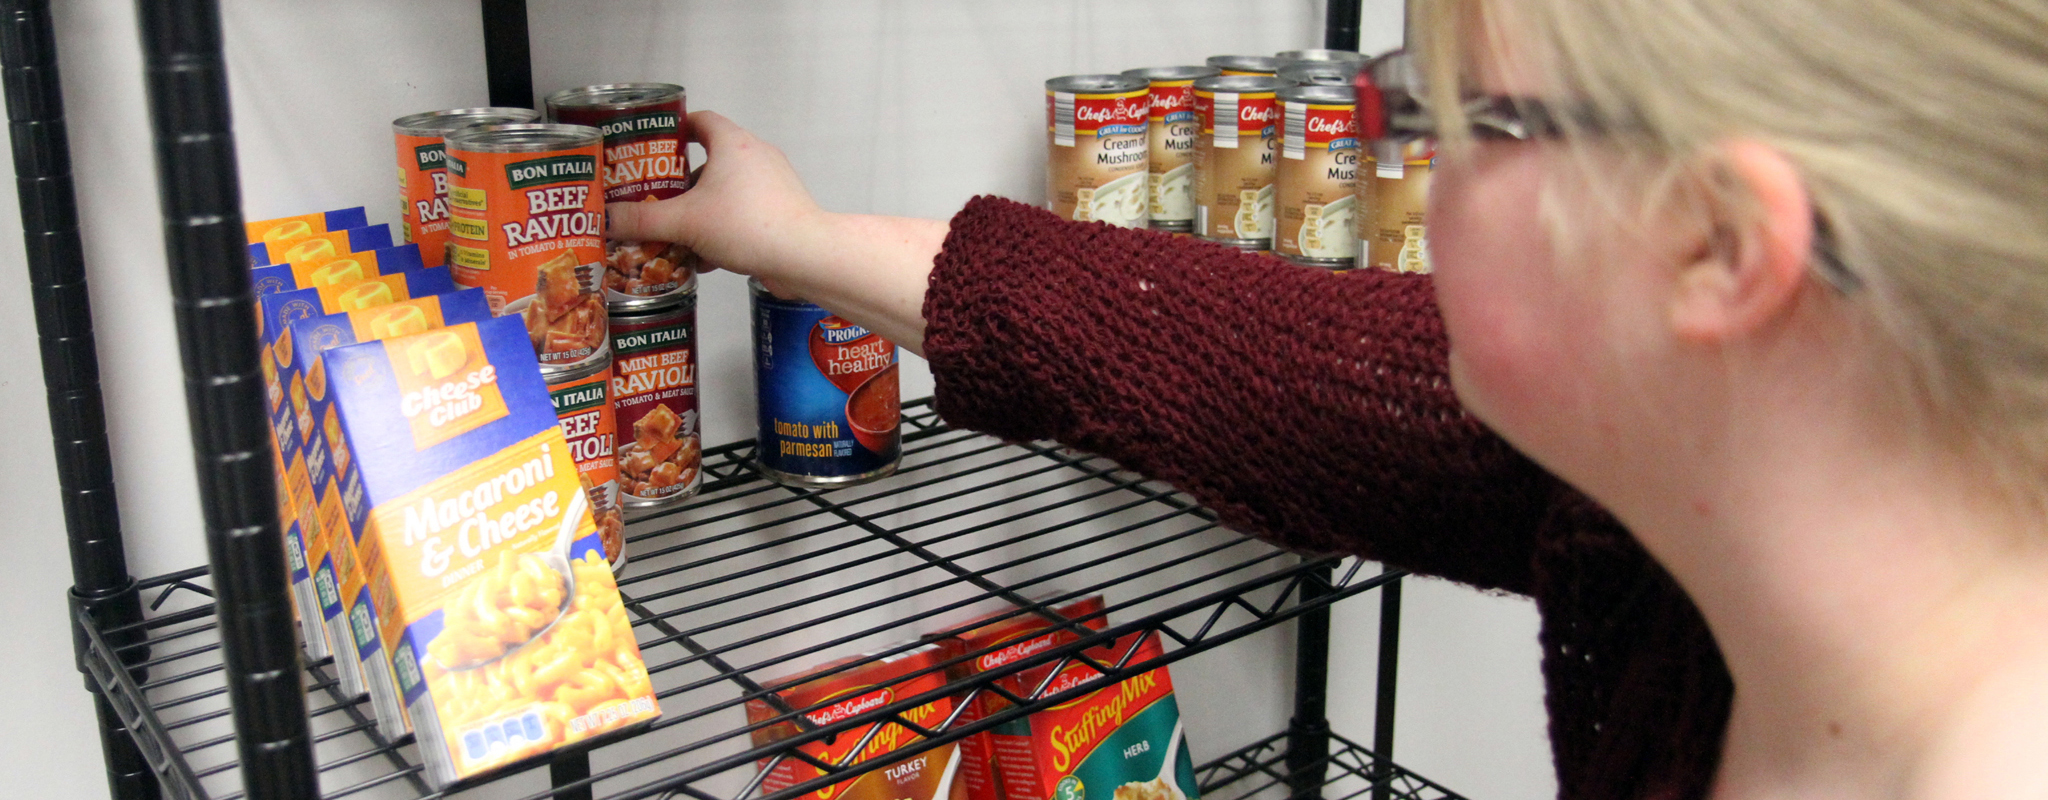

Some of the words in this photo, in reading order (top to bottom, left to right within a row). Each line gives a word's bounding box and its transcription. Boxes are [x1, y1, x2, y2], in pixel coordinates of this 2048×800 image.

[1077, 106, 1113, 123] Chef's
[1241, 106, 1274, 122] Chef's
[603, 121, 633, 136] BON
[637, 117, 675, 130] ITALIA
[1099, 126, 1119, 135] GREAT
[1308, 116, 1346, 135] Chef's
[606, 143, 645, 162] MINI
[649, 140, 677, 154] BEEF
[1104, 138, 1137, 151] Cream
[1331, 140, 1352, 149] GREAT
[1335, 152, 1356, 165] Cre
[512, 165, 548, 182] BON
[551, 162, 593, 176] ITALIA
[603, 156, 685, 187] RAVIOLI
[526, 186, 589, 214] BEEF
[611, 184, 642, 198] TOMATO
[651, 181, 669, 189] MEAT
[502, 212, 602, 247] RAVIOLI
[507, 249, 518, 260] IN
[519, 241, 556, 256] TOMATO
[557, 240, 564, 248] &
[565, 238, 584, 248] MEAT
[617, 335, 647, 349] BON
[651, 328, 687, 342] ITALIA
[540, 353, 551, 361] NET
[552, 352, 561, 360] WT
[562, 351, 569, 359] 15
[837, 338, 885, 361] heart
[621, 357, 658, 374] MINI
[661, 351, 689, 366] BEEF
[827, 351, 891, 376] healthy
[401, 365, 497, 417] Cheese
[613, 365, 695, 397] RAVIOLI
[564, 388, 604, 406] ITALIA
[622, 394, 653, 408] TOMATO
[662, 389, 679, 399] MEAT
[429, 391, 482, 427] Club
[558, 411, 600, 439] EEF
[774, 418, 809, 438] tomato
[812, 420, 839, 439] with
[780, 440, 833, 458] parmesan
[579, 461, 599, 473] MEAT
[404, 443, 554, 547] Macaroni
[420, 536, 455, 578] &
[458, 490, 560, 558] Cheese
[441, 558, 485, 589] DINNER
[984, 652, 1007, 668] Chef's
[1018, 633, 1054, 655] Cupboard
[846, 692, 884, 715] Cupboard
[1051, 695, 1122, 772] Stuffing
[1121, 669, 1156, 708] Mix
[1123, 740, 1150, 759] HERB
[884, 756, 927, 781] TURKEY
[897, 772, 920, 786] FLAVOR
[1065, 786, 1075, 800] 5
